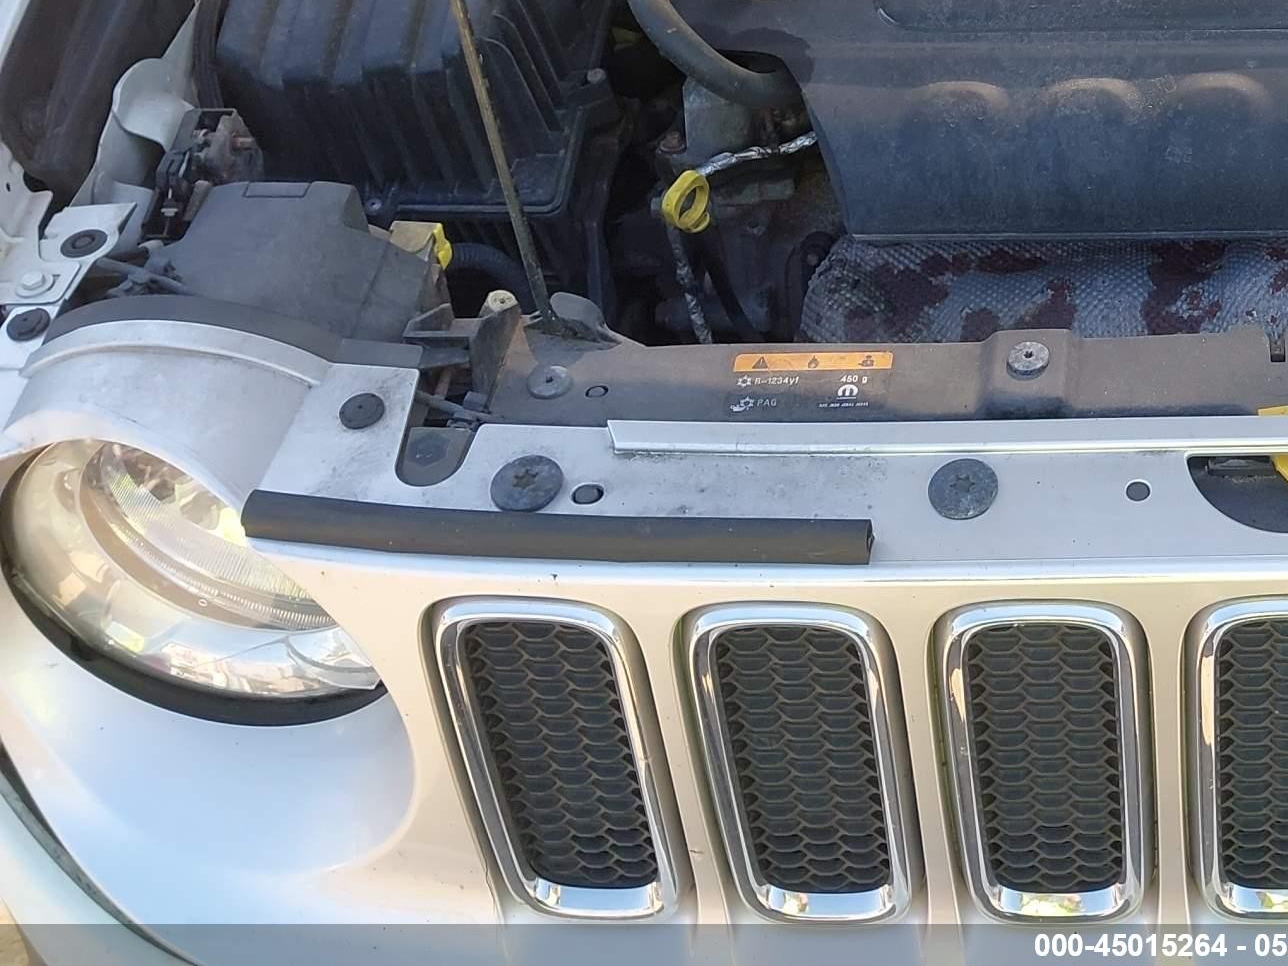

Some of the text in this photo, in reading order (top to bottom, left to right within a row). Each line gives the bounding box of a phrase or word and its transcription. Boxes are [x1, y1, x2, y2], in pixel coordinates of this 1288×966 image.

[754, 375, 800, 386] R-1234yf
[840, 374, 859, 383] 450
[756, 398, 777, 407] PAG
